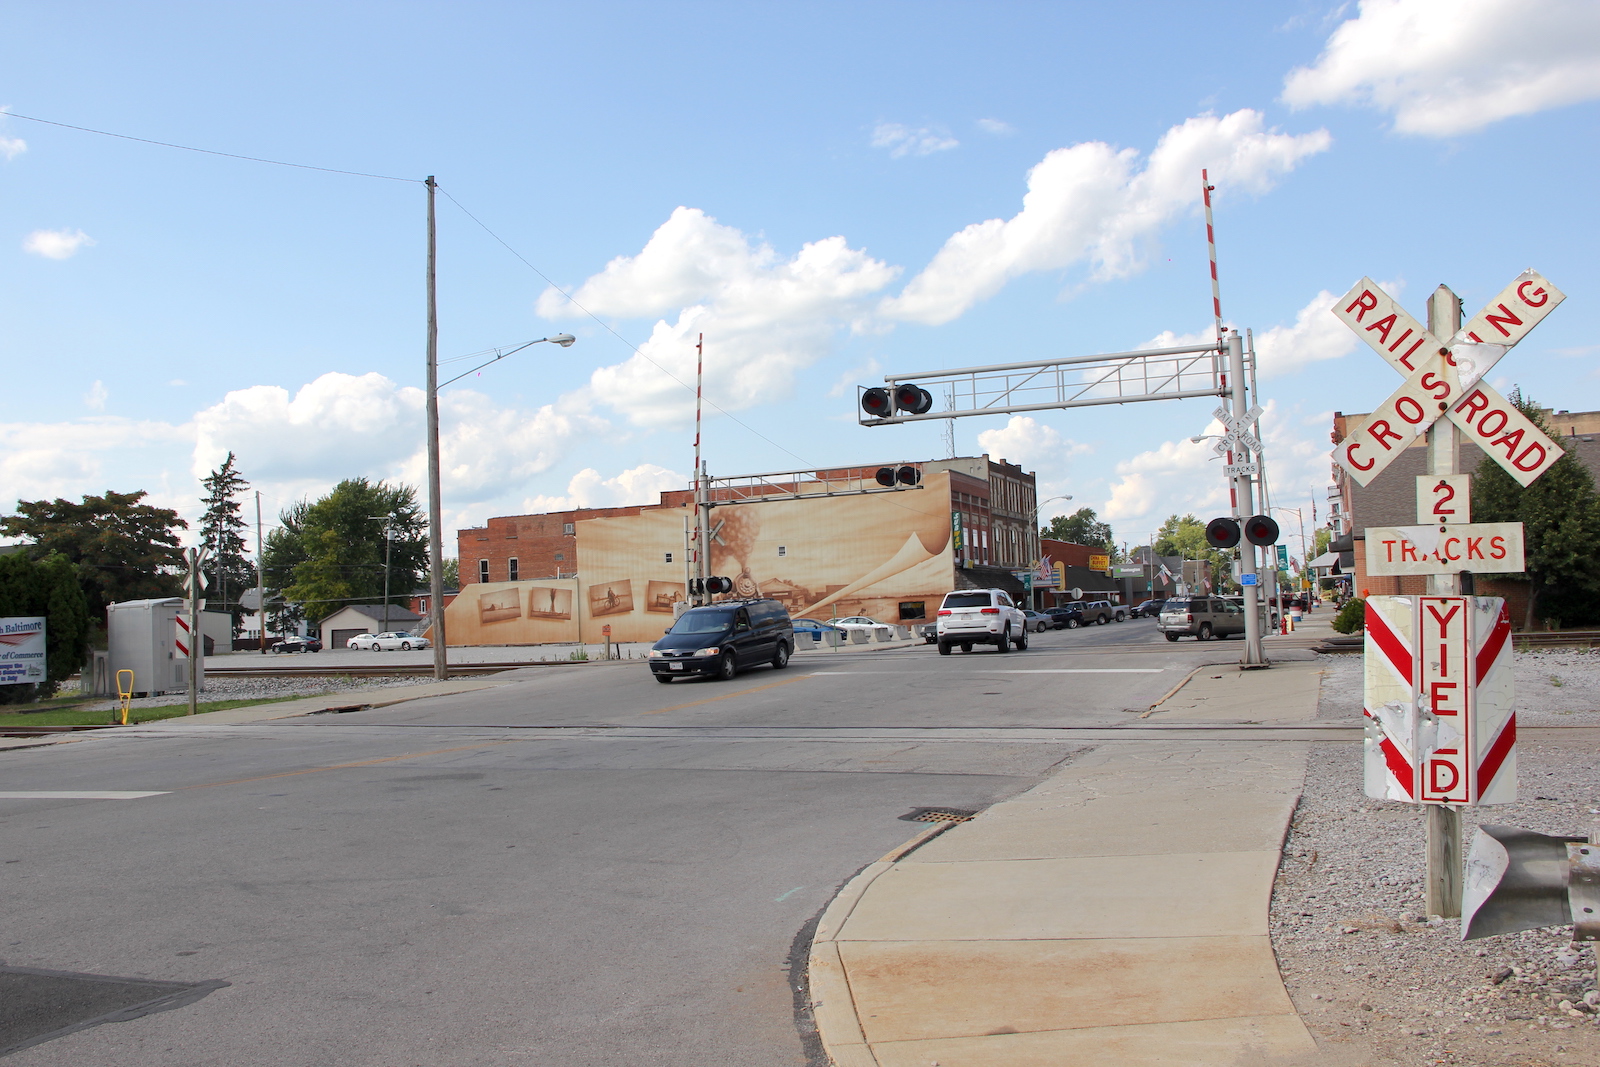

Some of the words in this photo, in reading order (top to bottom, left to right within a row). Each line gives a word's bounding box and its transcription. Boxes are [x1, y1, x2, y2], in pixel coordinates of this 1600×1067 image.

[1454, 388, 1547, 472] ROAD
[1227, 465, 1255, 473] TRACKS
[1432, 484, 1455, 515] 2
[953, 512, 961, 549] SUBWAY
[5, 621, 42, 633] Baltimore
[2, 651, 10, 659] of
[10, 651, 43, 659] Commerce
[1426, 605, 1460, 793] YIED
